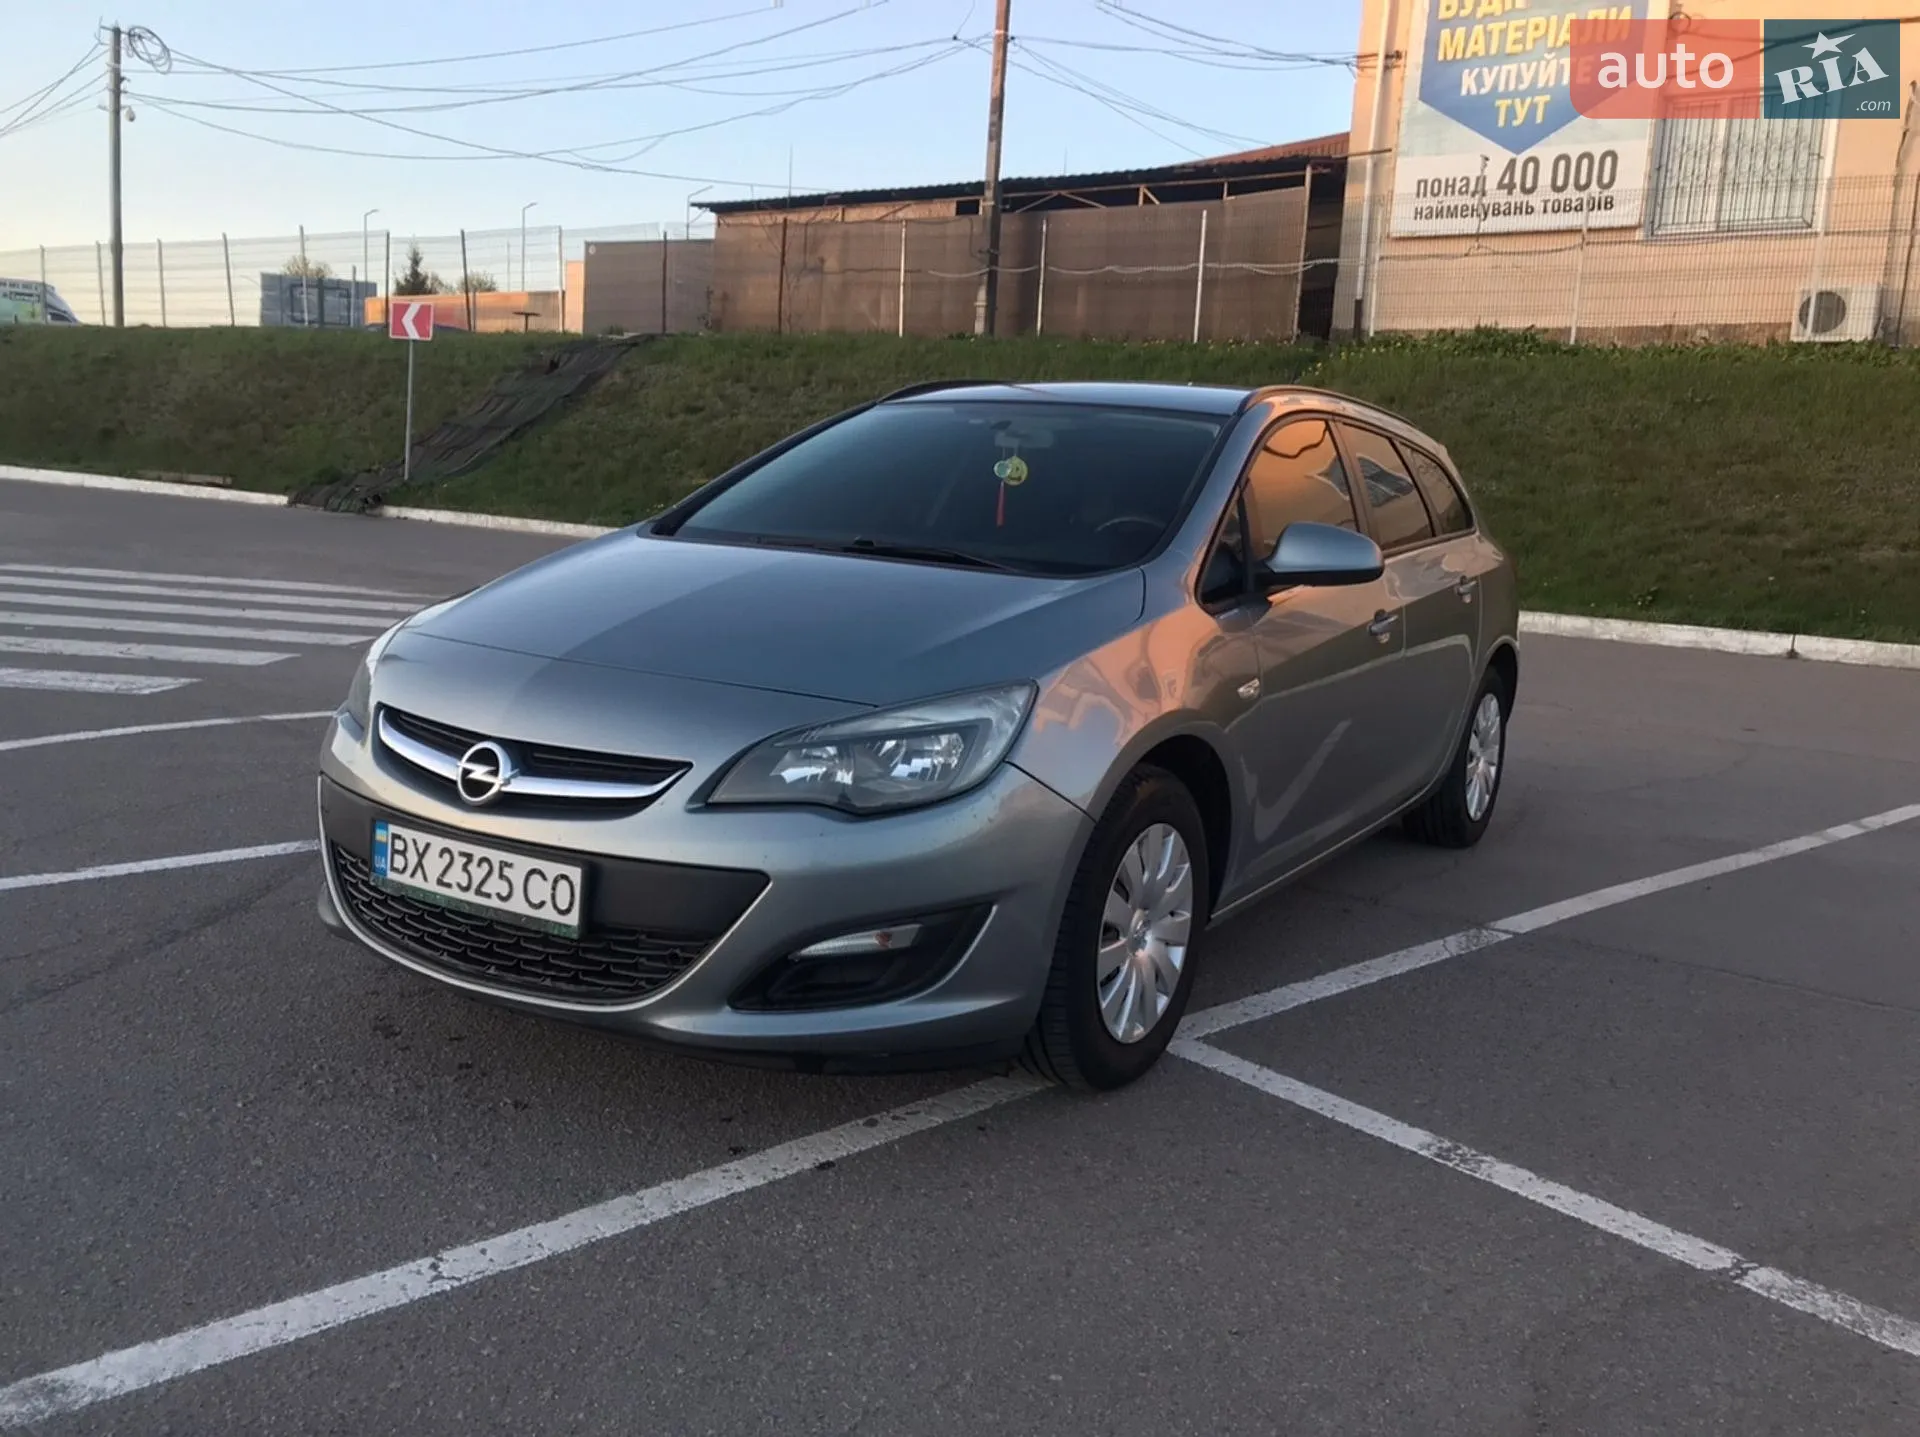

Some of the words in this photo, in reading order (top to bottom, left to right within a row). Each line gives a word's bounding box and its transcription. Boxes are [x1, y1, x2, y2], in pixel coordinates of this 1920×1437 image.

[1438, 6, 1632, 61] МАТЕРІАЛИ
[1460, 52, 1595, 96] КУПУЙТЕ
[1495, 94, 1551, 128] ТУТ
[1416, 175, 1487, 198] понад
[1496, 156, 1540, 195] 40
[1551, 150, 1618, 193] 000
[1414, 199, 1534, 221] найменувань
[1541, 191, 1614, 214] товарів
[374, 856, 386, 870] UA
[390, 832, 432, 883] BX
[436, 847, 514, 902] 2325
[523, 868, 575, 915] CO
